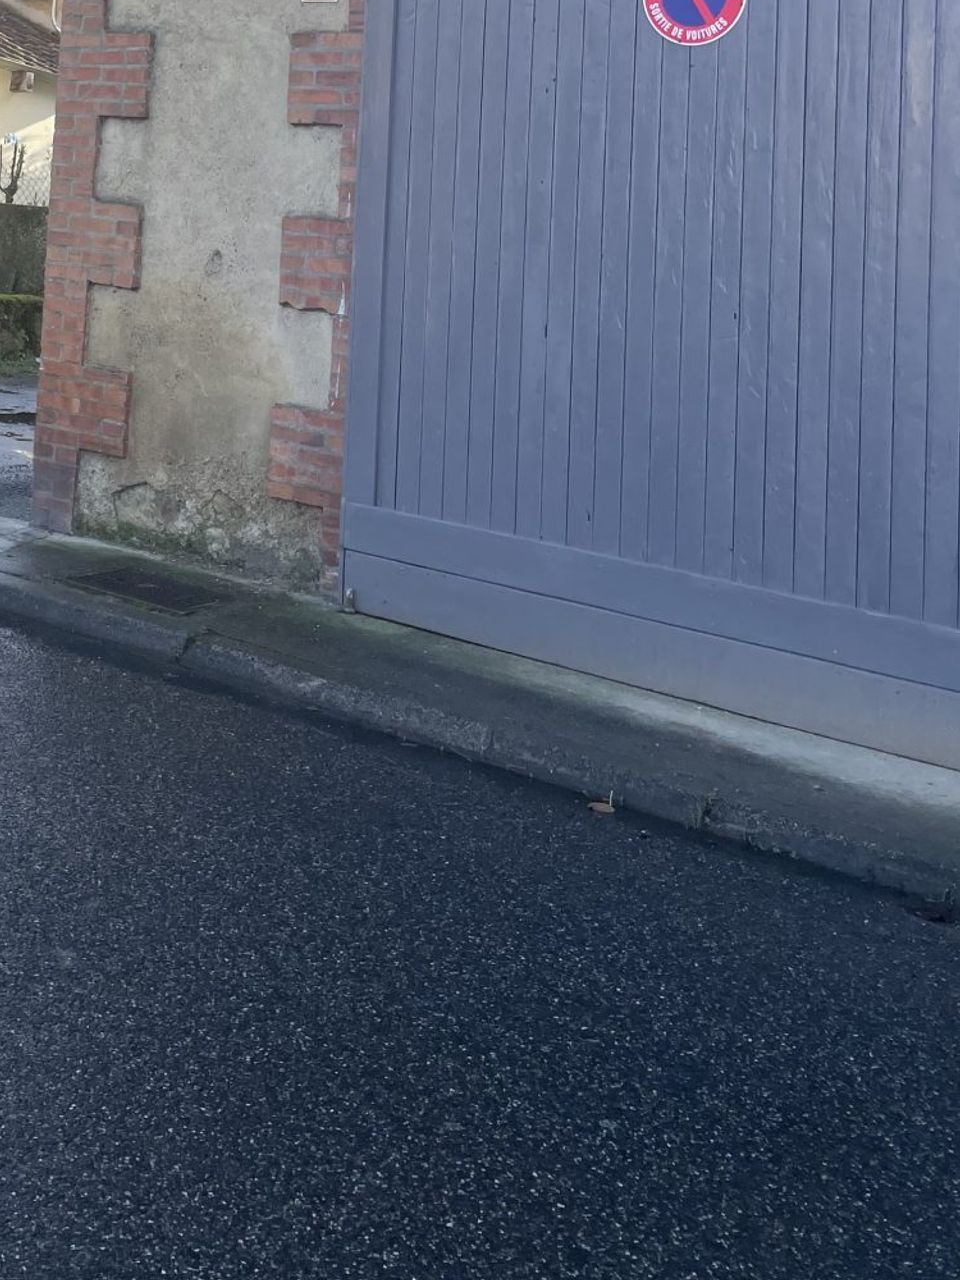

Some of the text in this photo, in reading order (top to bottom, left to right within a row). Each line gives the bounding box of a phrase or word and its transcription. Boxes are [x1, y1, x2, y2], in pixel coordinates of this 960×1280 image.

[649, 2, 729, 41] SORTIE DE VOITURES
